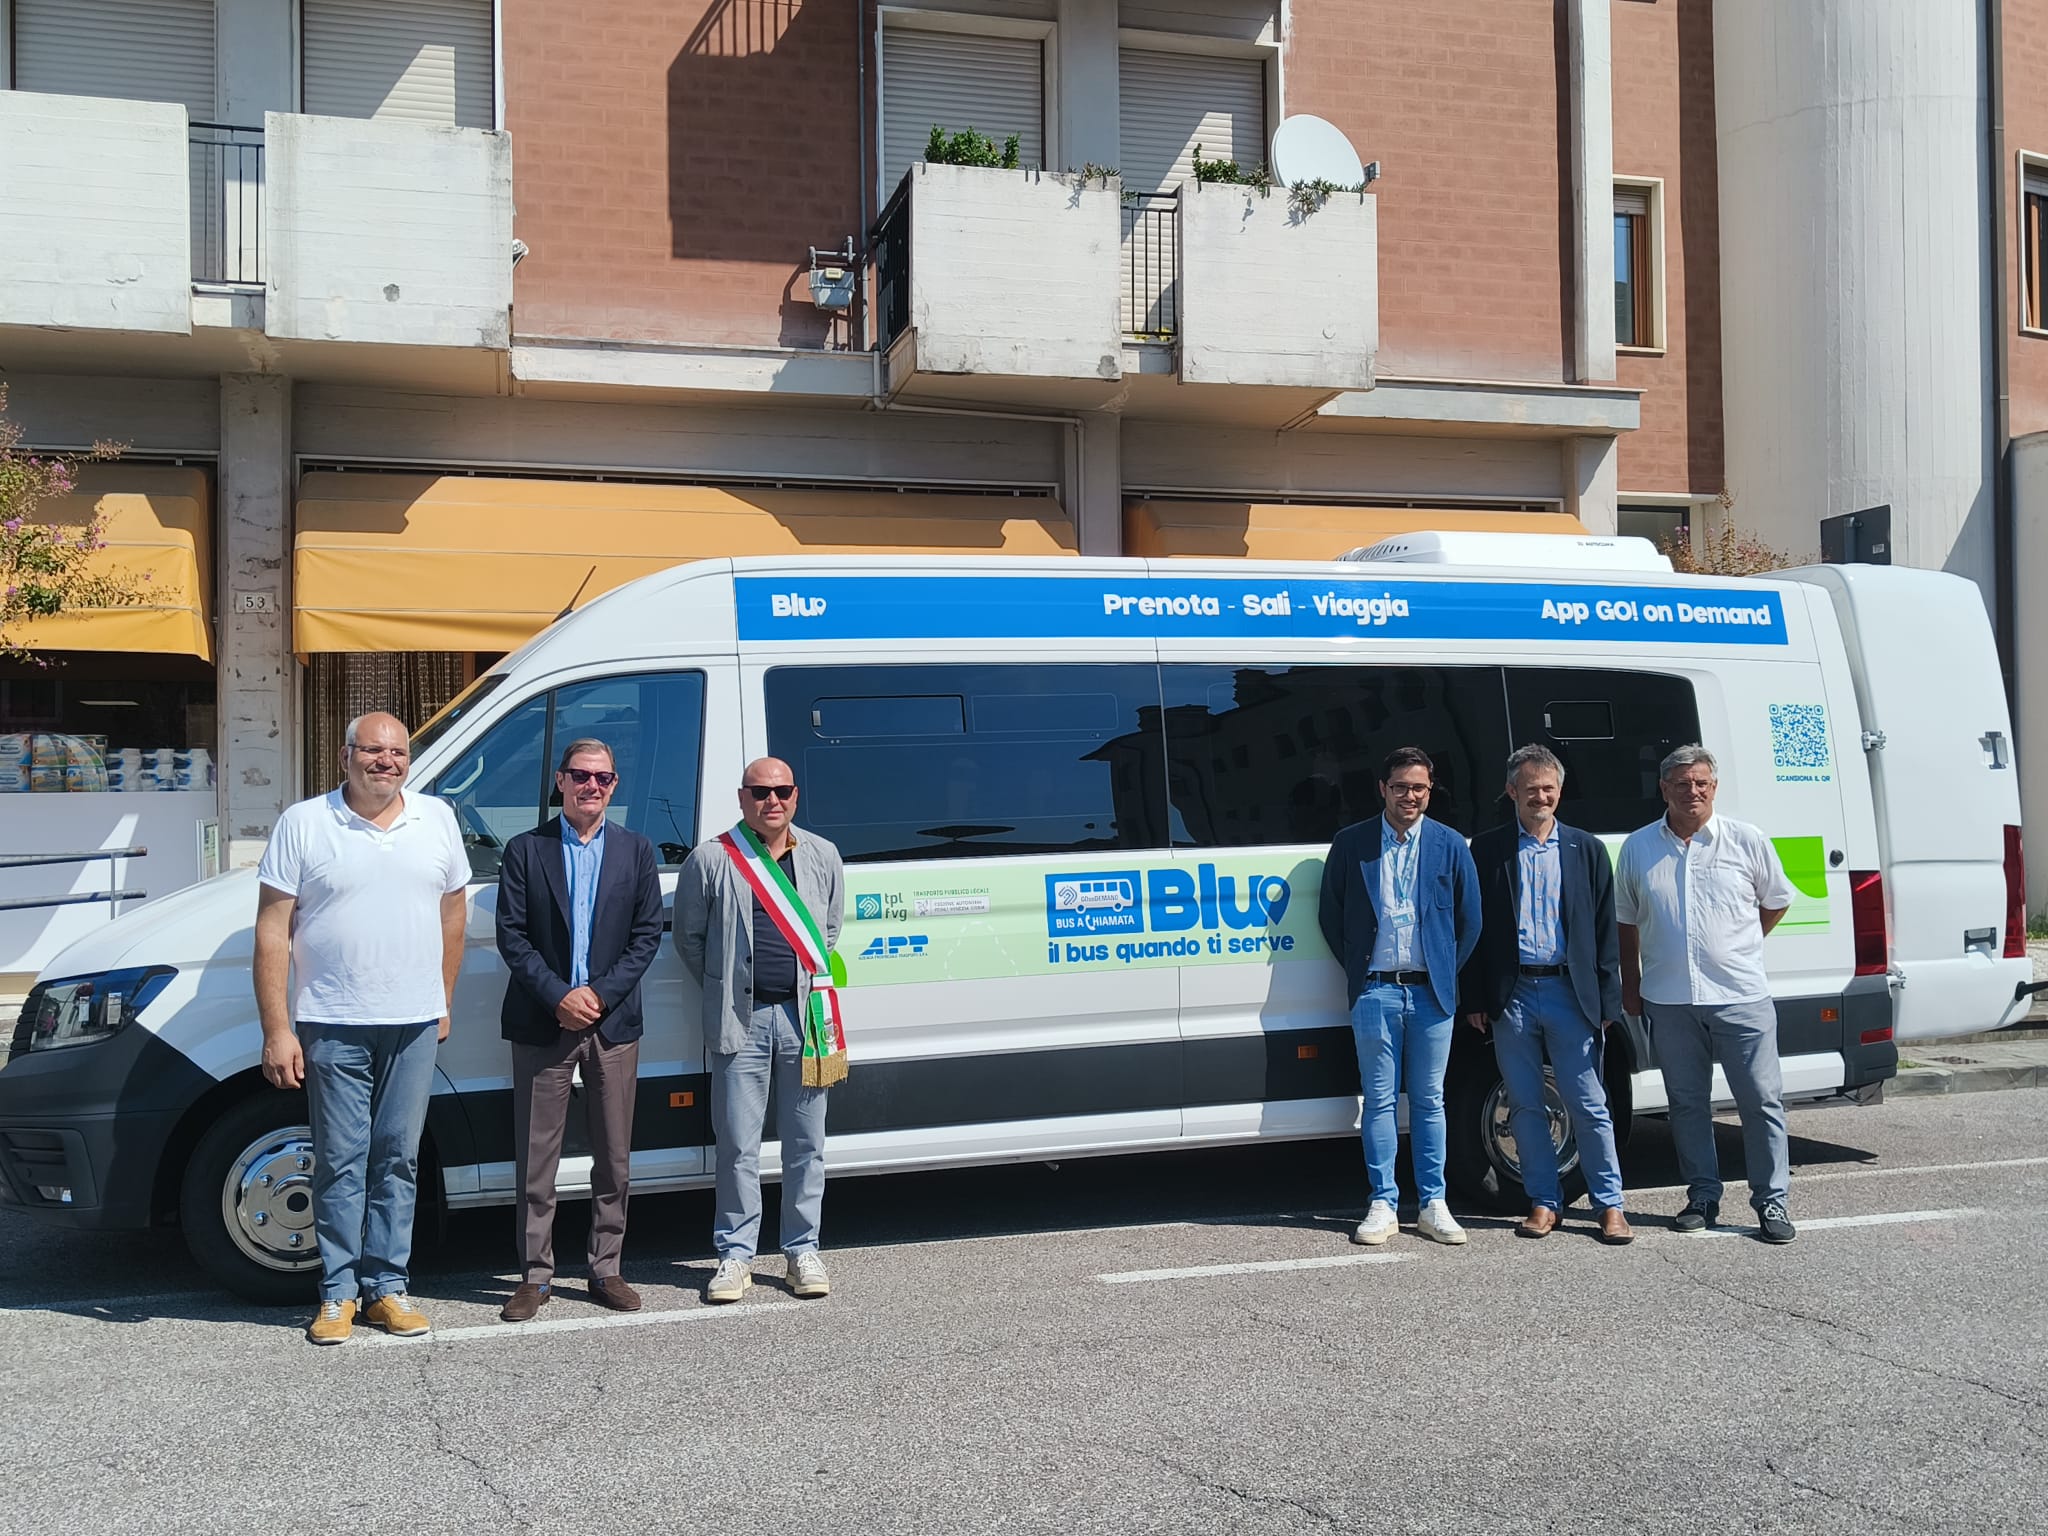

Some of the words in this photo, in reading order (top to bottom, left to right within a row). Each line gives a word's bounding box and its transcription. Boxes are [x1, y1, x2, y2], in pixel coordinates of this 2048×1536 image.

[246, 596, 265, 608] 53
[1103, 593, 1220, 616] Prenota
[1242, 591, 1291, 616] Sali
[1312, 592, 1410, 626] Viaggia
[1541, 599, 1590, 625] App
[1595, 600, 1639, 622] GO!
[1642, 604, 1674, 622] on
[1677, 603, 1772, 625] Demand
[884, 892, 904, 908] tpl
[884, 907, 908, 922] fvg
[1056, 918, 1075, 928] BUS
[1077, 918, 1084, 927] A
[859, 934, 929, 956] APT
[1048, 942, 1059, 963] il
[1066, 943, 1109, 962] bus
[1116, 937, 1200, 963] quando
[1207, 933, 1221, 954] ti
[1228, 935, 1295, 954] serve
